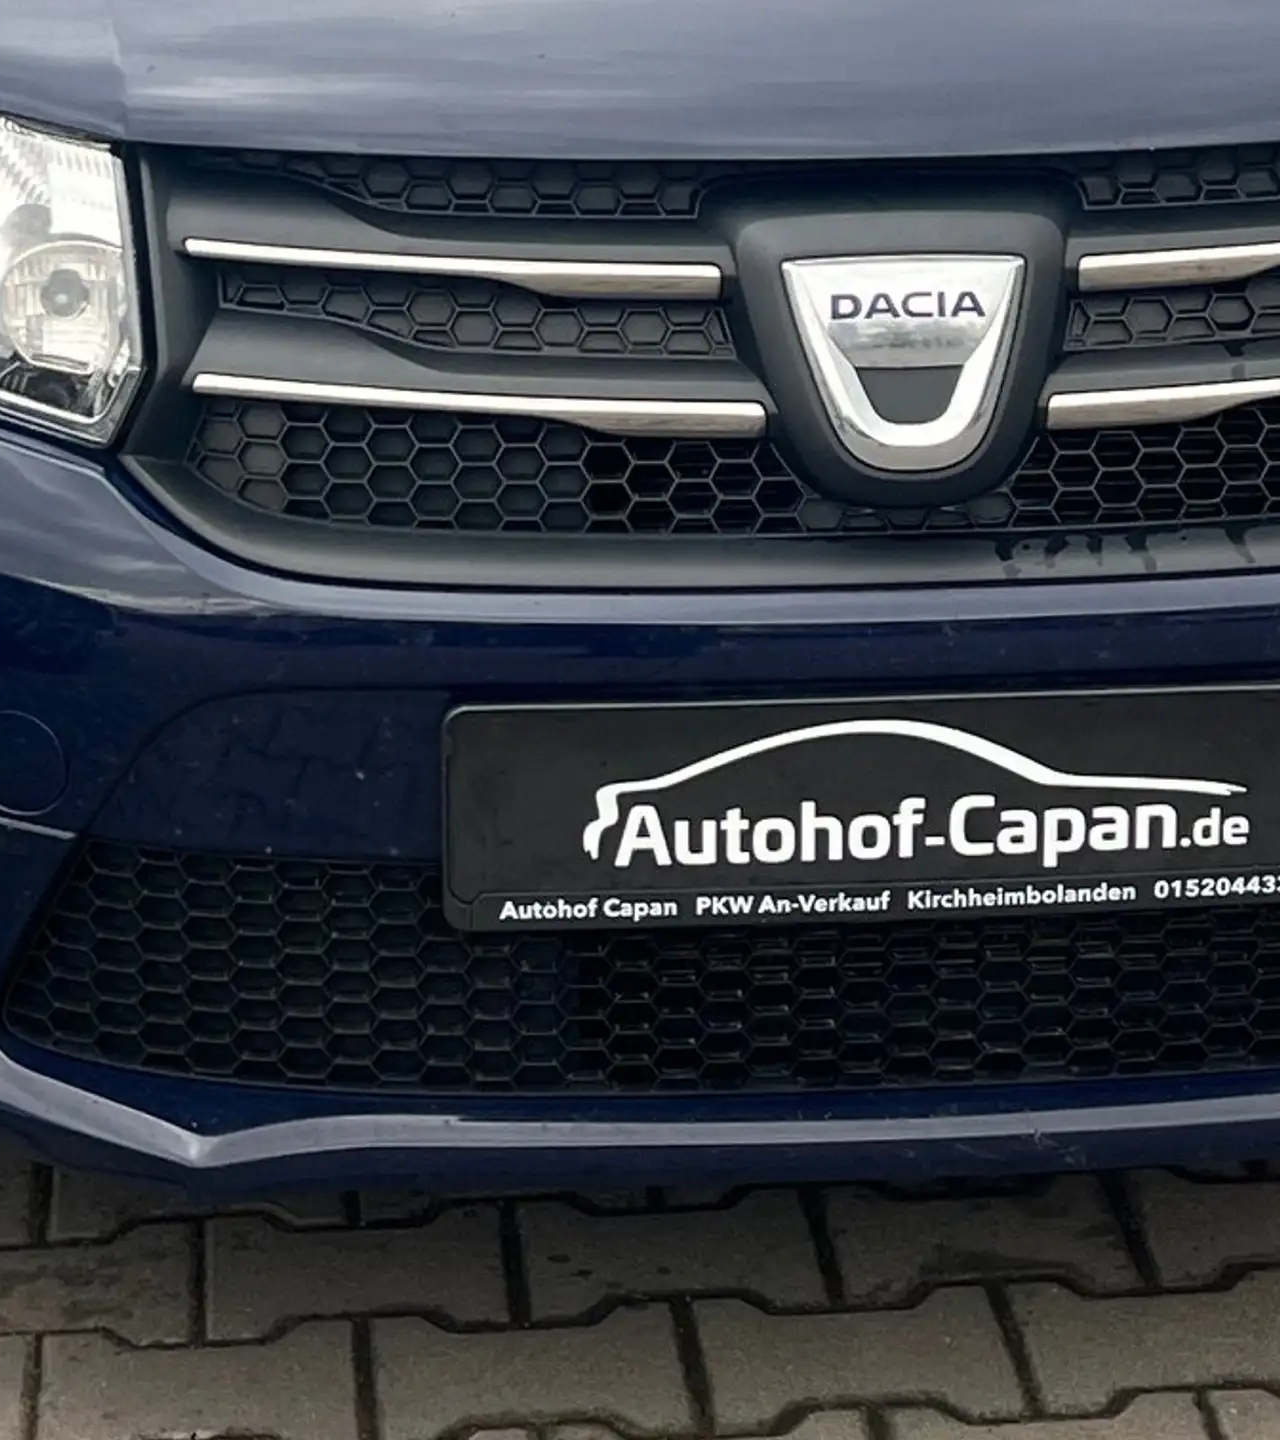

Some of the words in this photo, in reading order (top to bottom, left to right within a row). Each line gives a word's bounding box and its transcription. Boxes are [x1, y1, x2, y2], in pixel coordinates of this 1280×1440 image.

[830, 291, 986, 320] DACIA
[614, 794, 1251, 867] Autohof-Capan.de
[499, 897, 599, 920] Autohof
[603, 898, 678, 921] Capan
[696, 895, 754, 915] PKW
[758, 890, 891, 914] An-Verkauf
[907, 882, 1137, 910] Kirchheimbolanden
